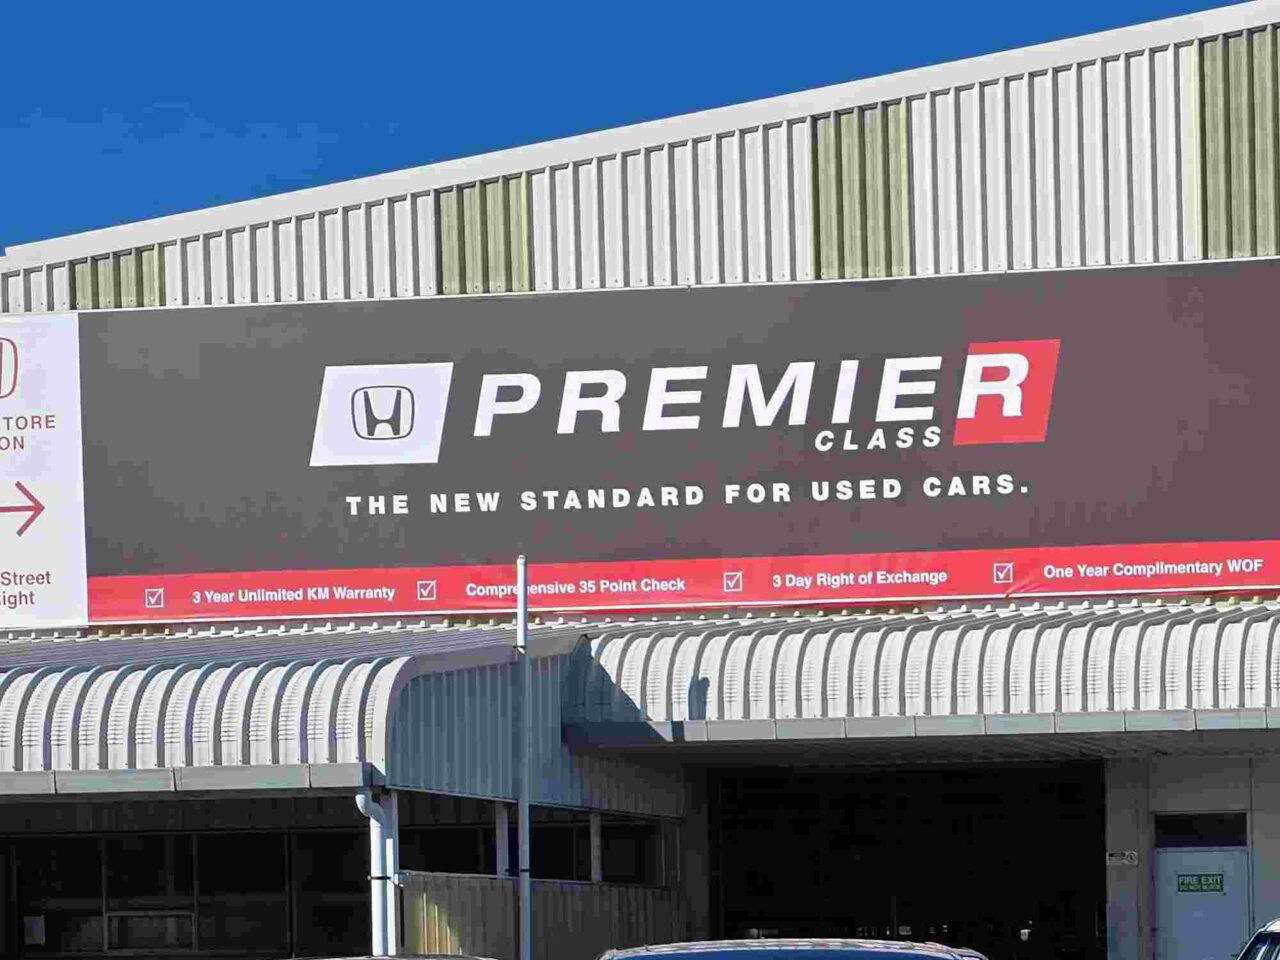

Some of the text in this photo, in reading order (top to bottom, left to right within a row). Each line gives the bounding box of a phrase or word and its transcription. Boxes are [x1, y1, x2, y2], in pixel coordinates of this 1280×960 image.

[473, 352, 1029, 437] PREMIER
[814, 425, 941, 452] CLASS
[346, 474, 1029, 516] THE NEW STANDARD FOR USED CARS.
[0, 570, 51, 586] Street
[1043, 558, 1264, 579] One Year Complimentary WOF
[465, 577, 686, 598] Compreensive 35 Point Check
[772, 569, 948, 589] 3 Day Right of Exchange
[0, 590, 35, 609] ight
[192, 586, 396, 604] 3 Year Unlimited KM Warranty
[1179, 876, 1222, 885] FIRE EXIT
